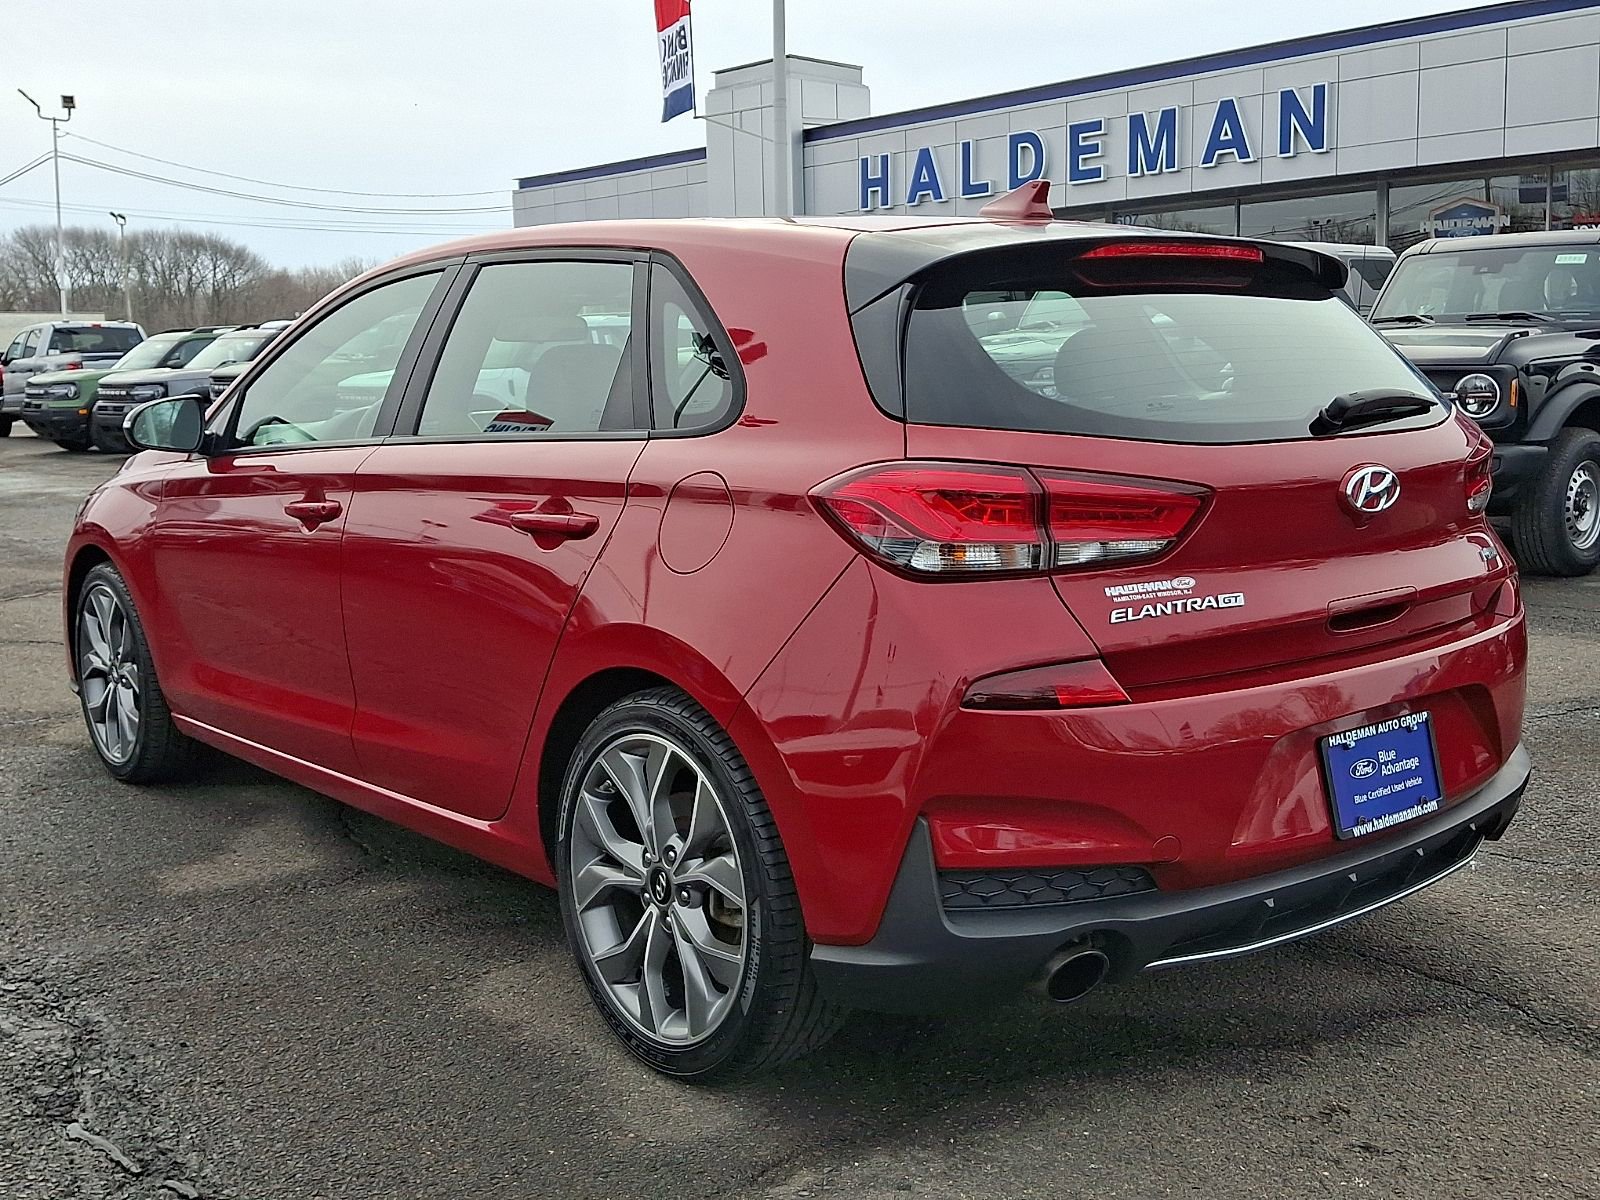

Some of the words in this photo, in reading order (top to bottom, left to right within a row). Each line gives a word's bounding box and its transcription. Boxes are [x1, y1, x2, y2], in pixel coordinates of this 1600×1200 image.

[859, 82, 1329, 211] HALDEMAN
[1105, 580, 1172, 597] HALDEMAN
[1110, 596, 1218, 624] ELANTRA
[1220, 594, 1242, 605] GT
[1329, 727, 1377, 747] HALDEMAN
[1378, 719, 1399, 734] AUTO
[1400, 711, 1428, 728] GROUP
[1353, 761, 1375, 777] Ford
[1378, 749, 1397, 763] Blue
[1381, 756, 1420, 777] Advantage
[1354, 793, 1368, 805] Blue
[1368, 785, 1392, 800] Certified
[1391, 781, 1405, 793] Used
[1405, 775, 1423, 789] Vehicle
[1352, 800, 1439, 838] www.haldemanauto.com
